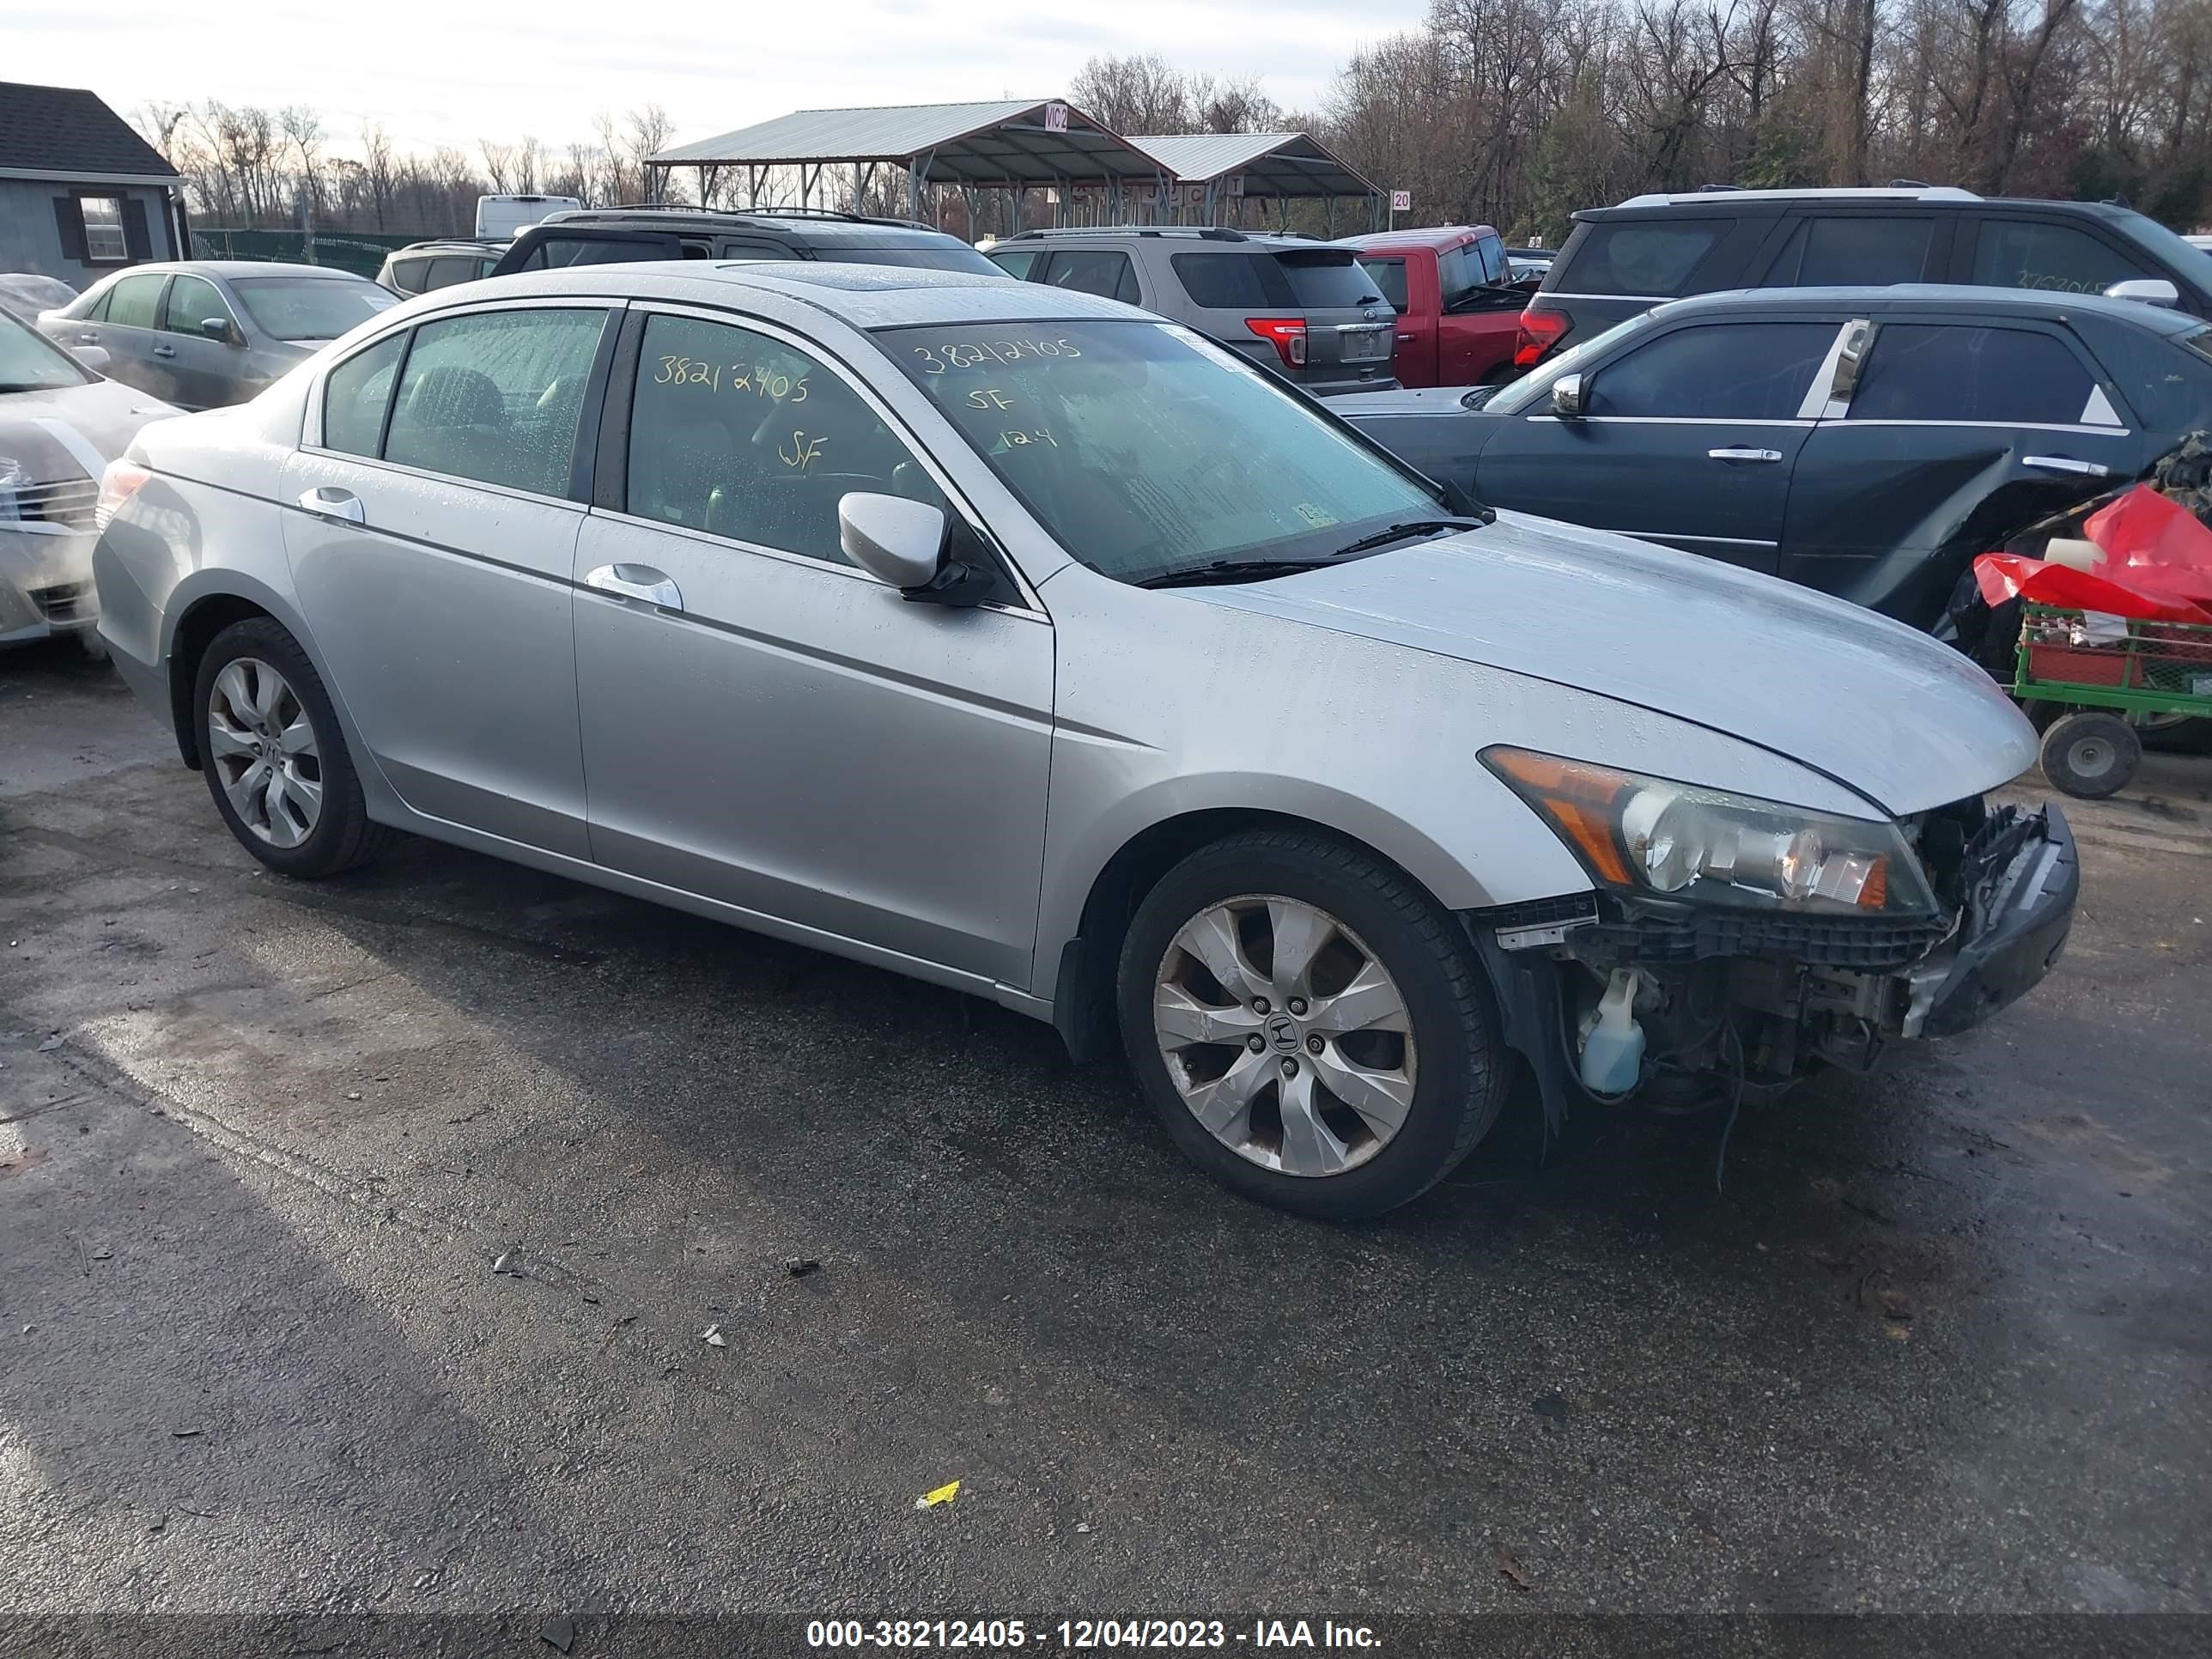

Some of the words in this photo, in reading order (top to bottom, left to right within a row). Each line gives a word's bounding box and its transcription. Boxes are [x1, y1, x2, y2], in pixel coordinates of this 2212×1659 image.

[1047, 106, 1060, 128] VIC
[1060, 108, 1067, 129] 2
[1190, 189, 1201, 202] C
[1231, 178, 1240, 192] T
[1395, 193, 1409, 207] 20
[914, 339, 1082, 374] 38212405
[965, 389, 1015, 410] SF
[778, 430, 830, 471] SF
